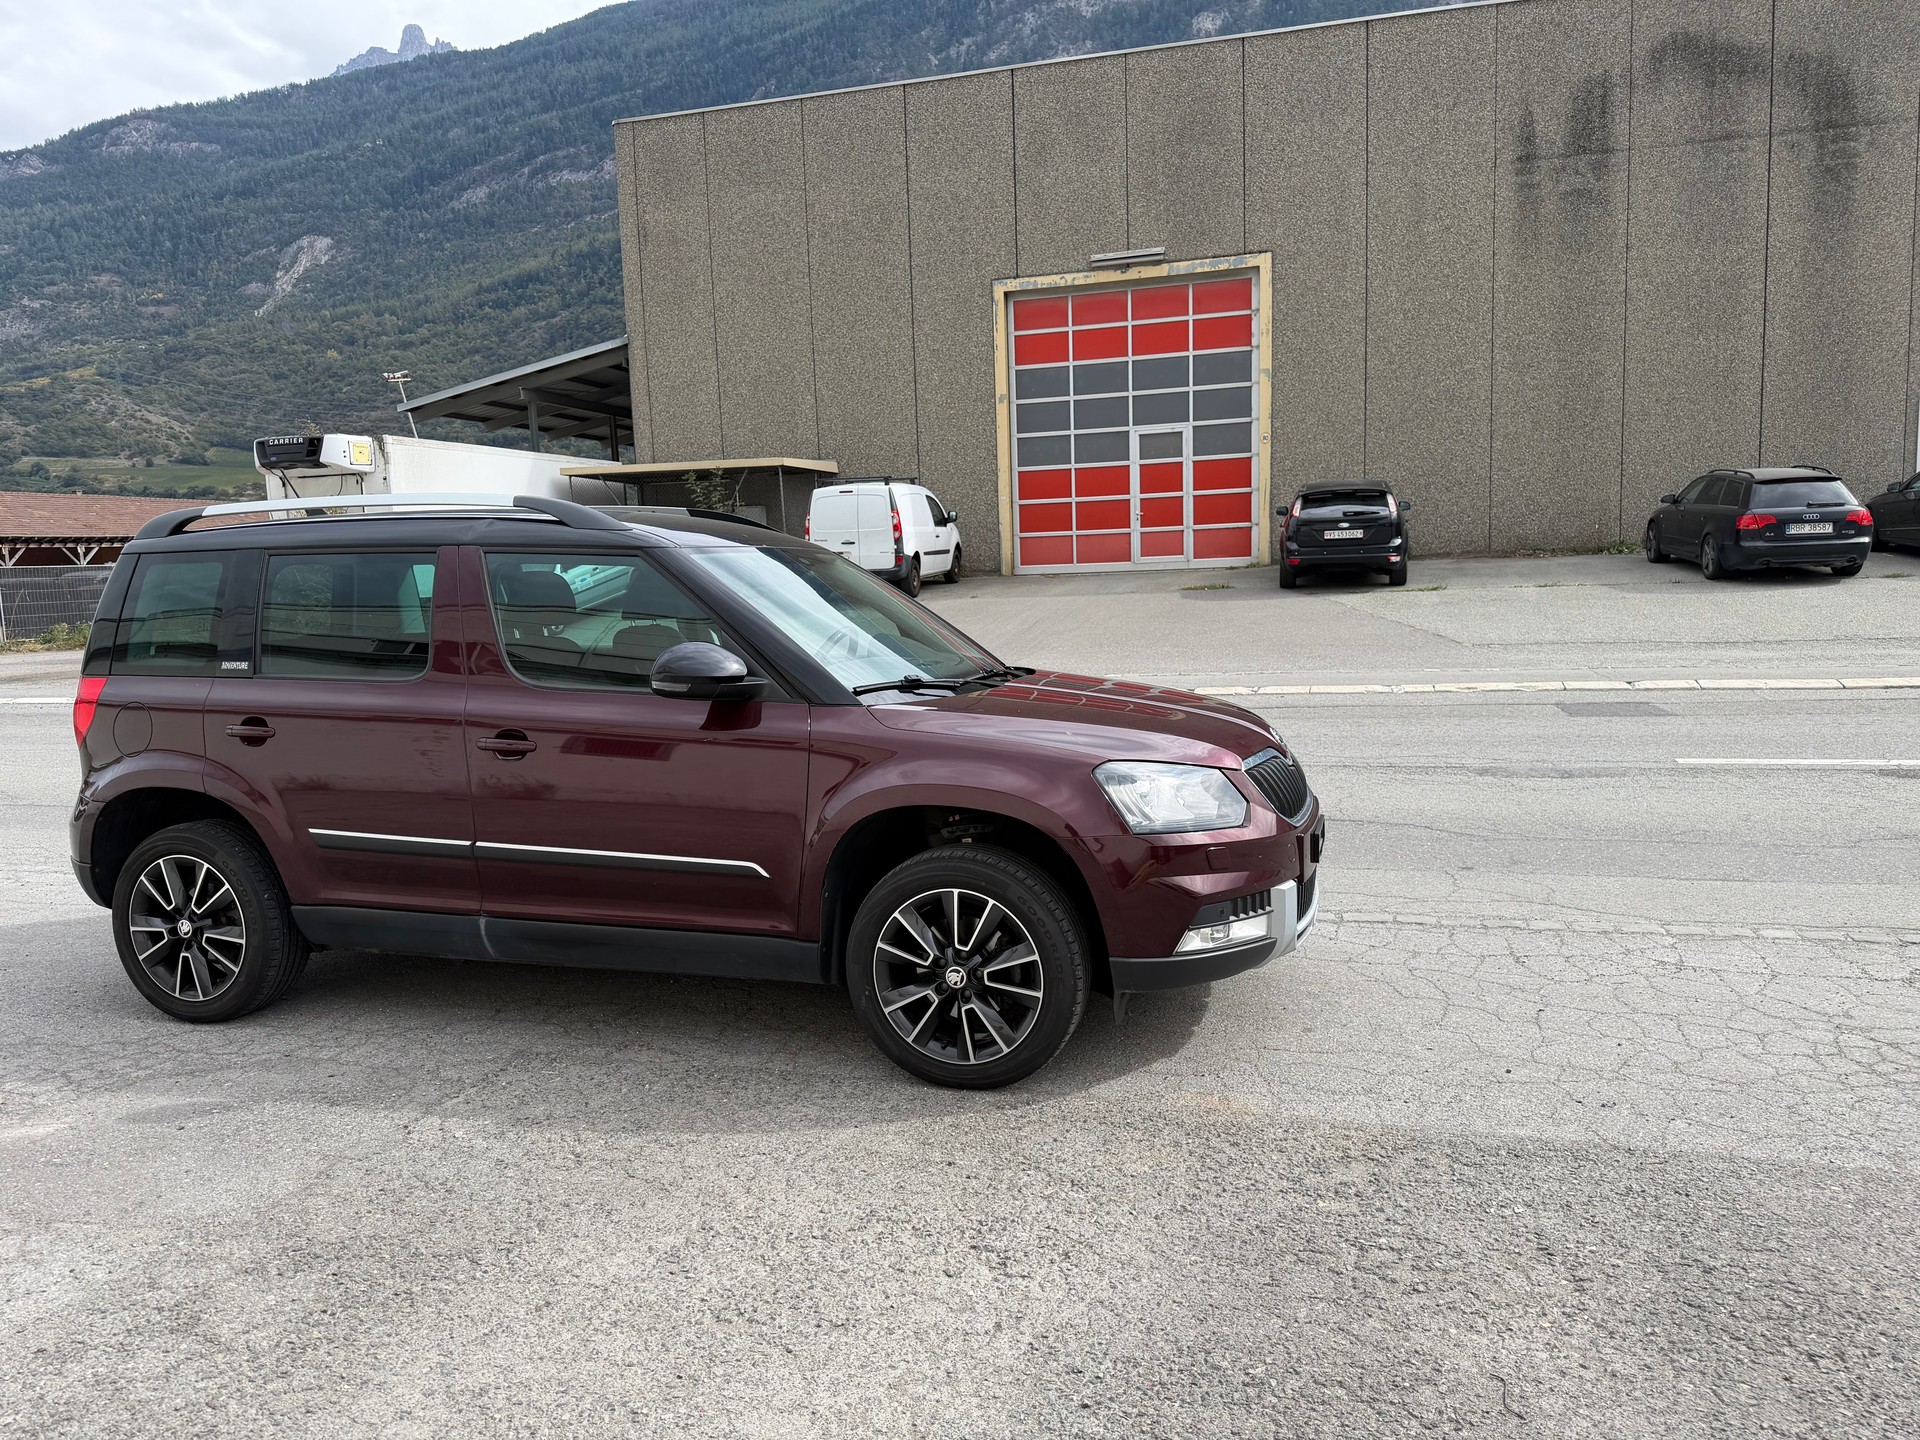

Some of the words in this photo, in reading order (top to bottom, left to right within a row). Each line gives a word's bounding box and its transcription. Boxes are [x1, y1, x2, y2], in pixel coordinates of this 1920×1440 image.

[269, 437, 304, 445] CARRIER
[1790, 523, 1806, 532] RBR
[1807, 523, 1832, 532] 38587
[220, 661, 249, 670] ADVENTURE
[1016, 895, 1065, 989] GOODRIDE
